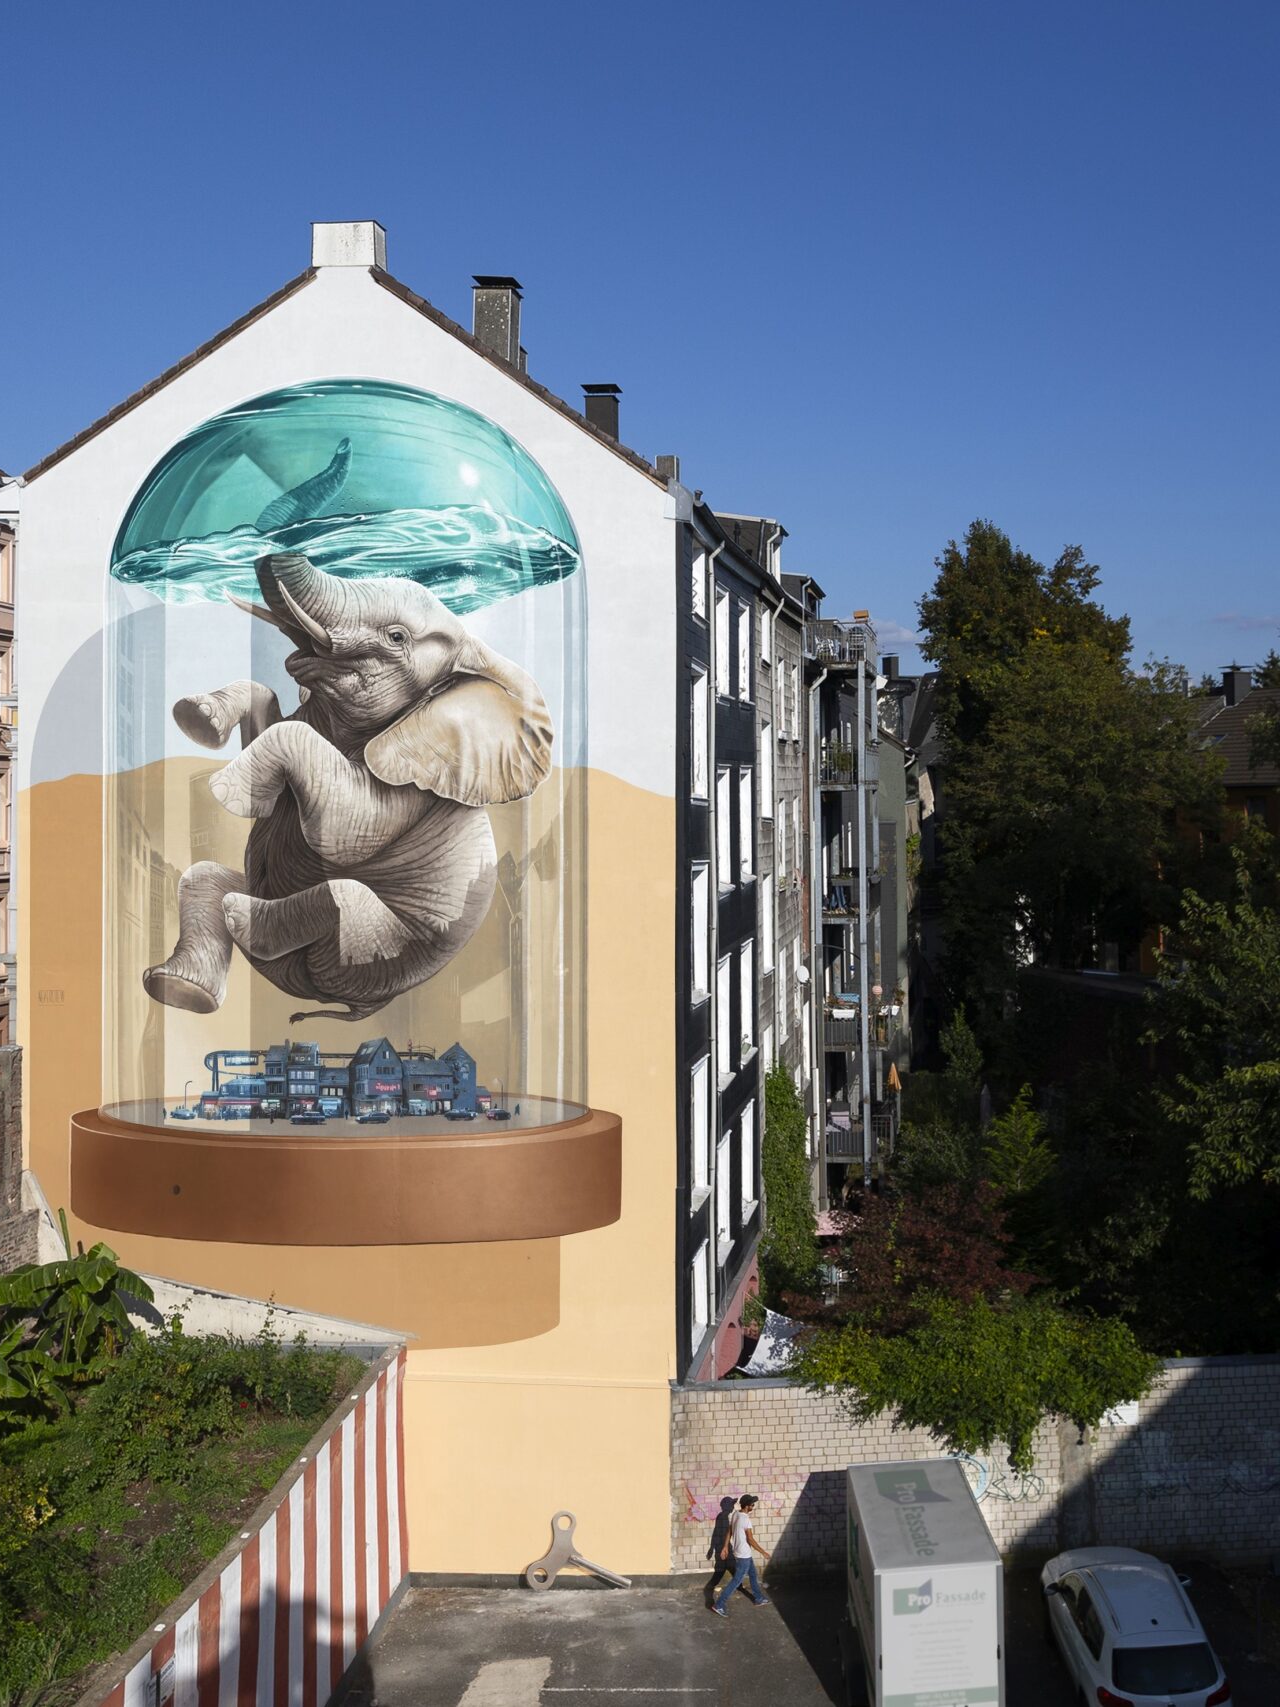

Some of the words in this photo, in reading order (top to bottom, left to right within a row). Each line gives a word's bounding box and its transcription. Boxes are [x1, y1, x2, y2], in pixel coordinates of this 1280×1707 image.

[894, 1482, 916, 1503] Pro
[903, 1504, 940, 1557] Fassade
[907, 1593, 931, 1607] Pro
[935, 1588, 987, 1604] Fassade
